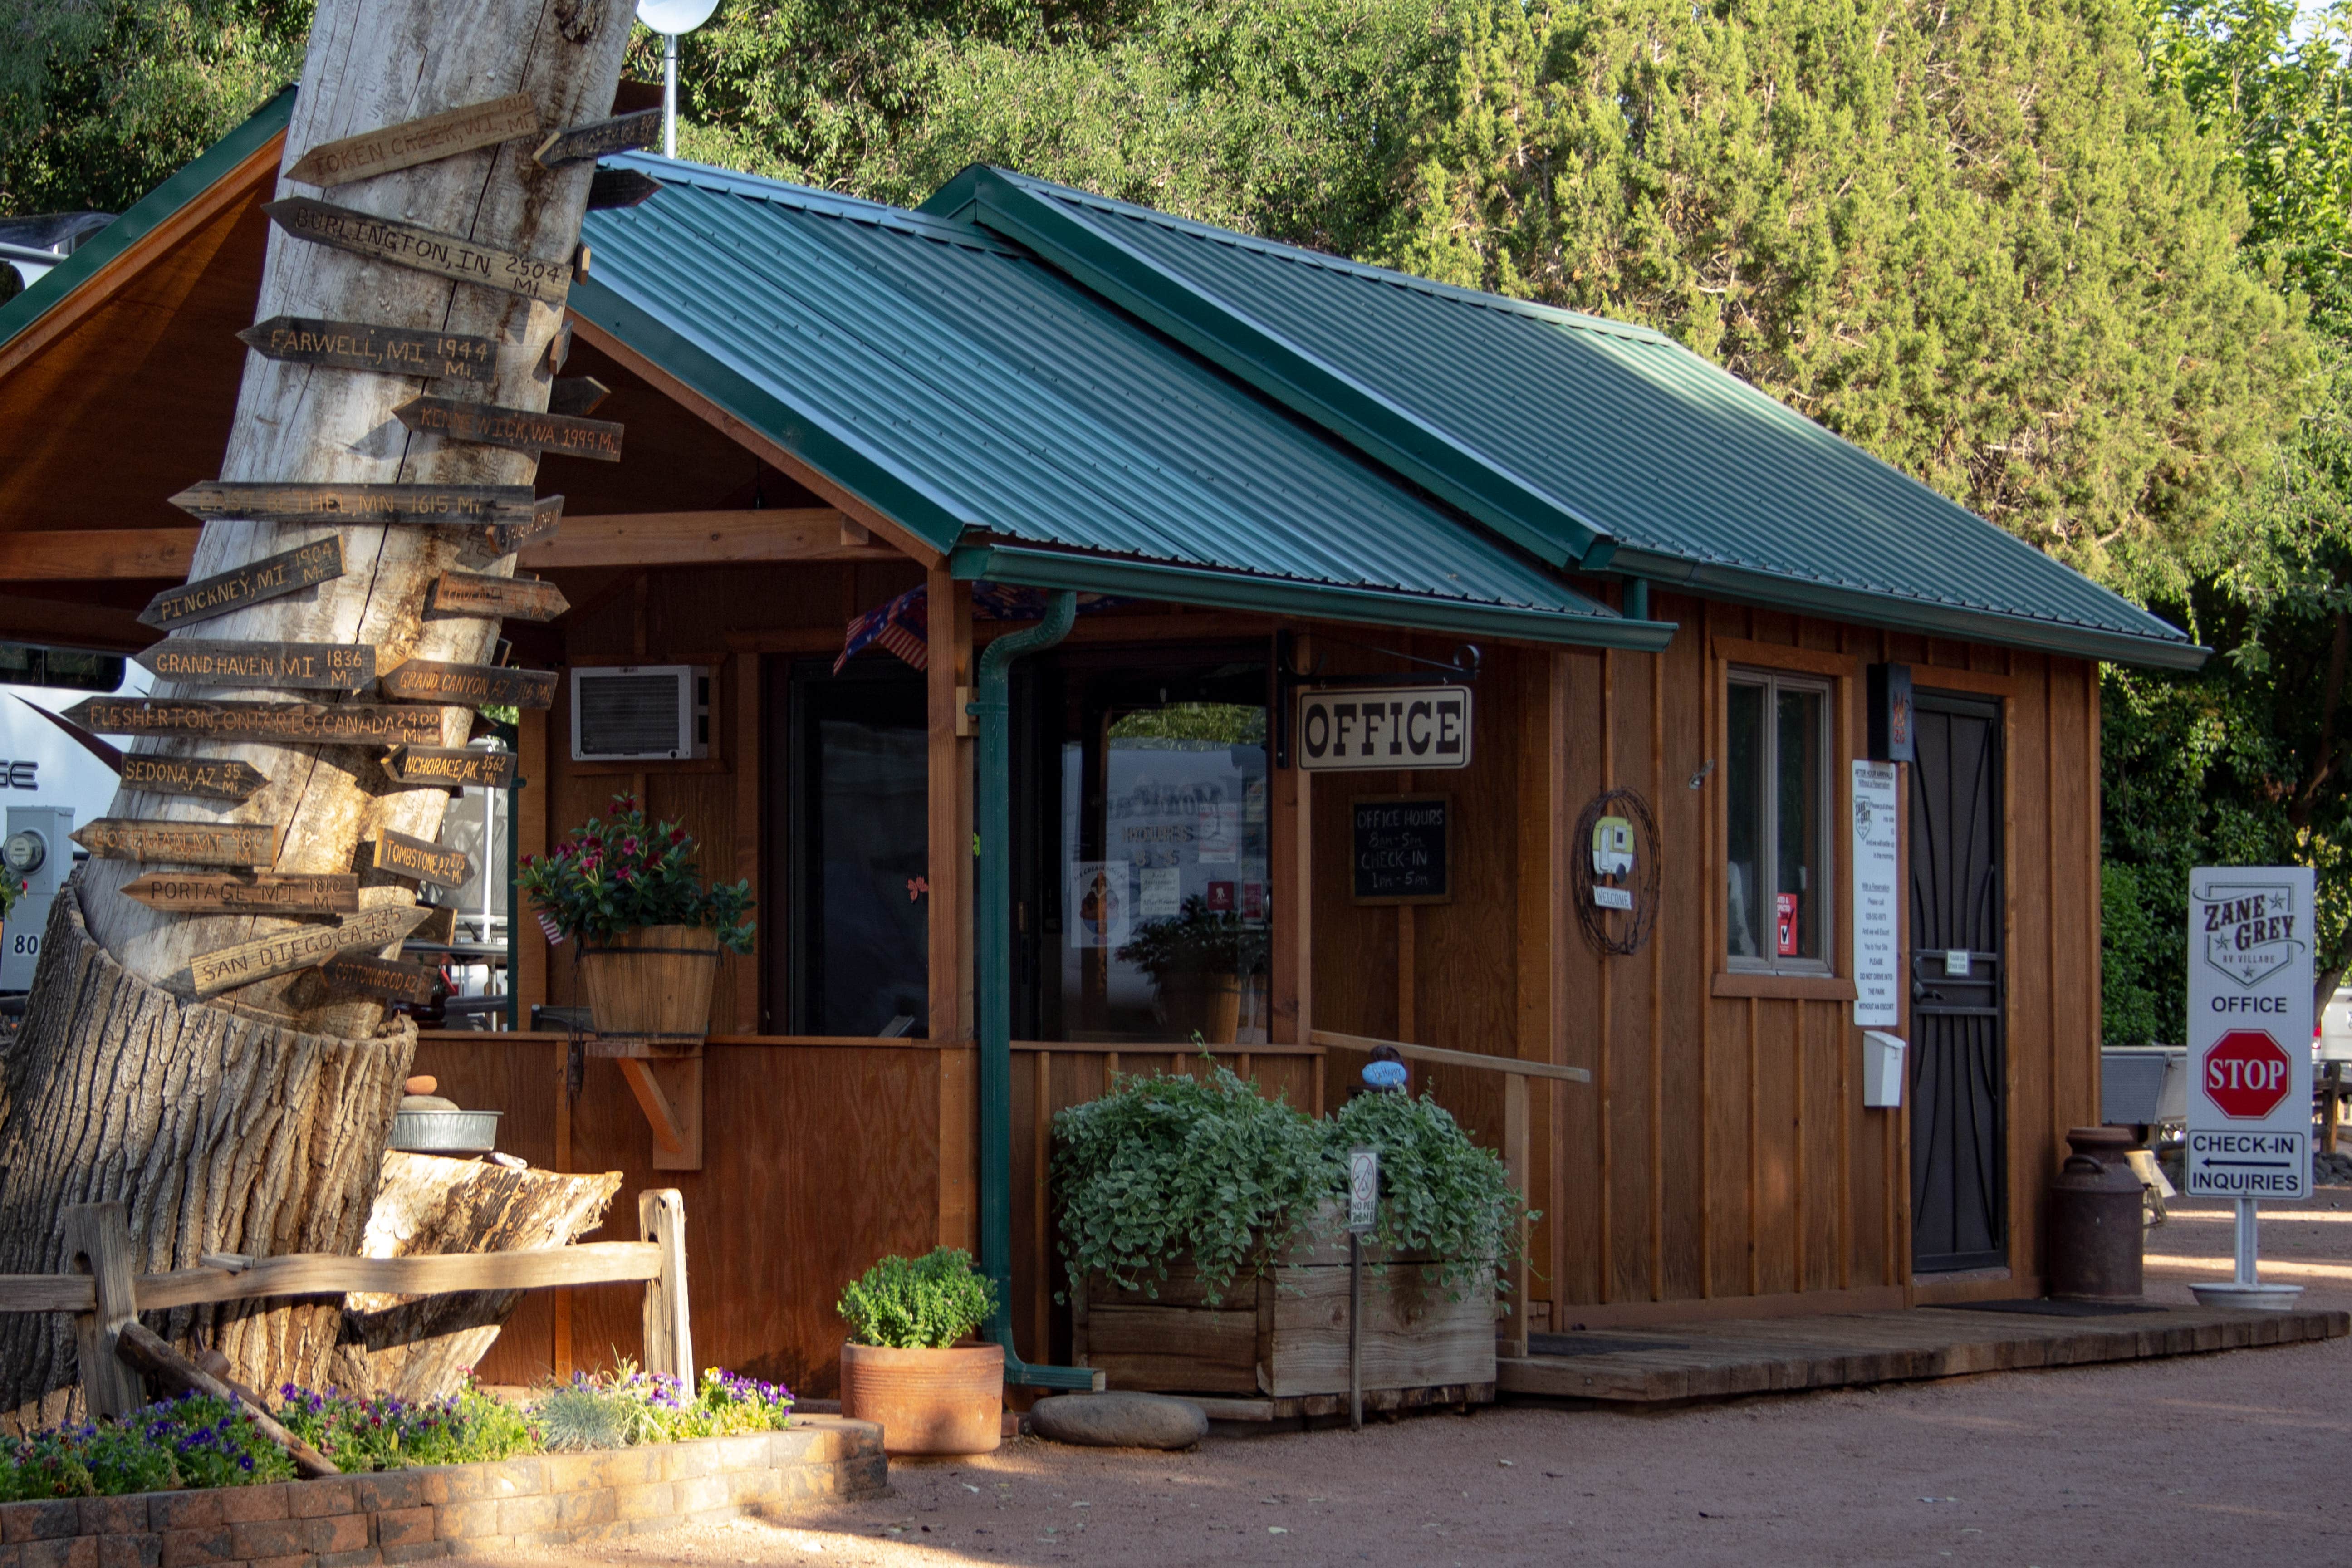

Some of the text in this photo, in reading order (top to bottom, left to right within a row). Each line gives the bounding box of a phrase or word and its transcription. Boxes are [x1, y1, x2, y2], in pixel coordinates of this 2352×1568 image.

[500, 96, 527, 114] 1810
[311, 142, 383, 176] TOKEN
[391, 124, 464, 155] CREEK,
[296, 207, 451, 270] BURLINGTON,
[506, 256, 560, 284] 2504
[272, 329, 383, 364] FARWELL,
[437, 338, 487, 361] 1944
[561, 428, 595, 449] 1999
[200, 491, 255, 512] EAST
[266, 491, 358, 517] BETHEL,
[359, 494, 394, 513] MN
[412, 495, 448, 514] 1615
[295, 542, 334, 567] 1904
[162, 576, 255, 621] PINCKNEY,
[157, 653, 212, 674] GRAND
[281, 656, 314, 678] MI
[327, 650, 363, 668] 1836
[400, 671, 438, 690] GRAND
[90, 705, 439, 737] FLESHERTON, ONTARIO, CANADA 2400
[1305, 701, 1460, 758] OFFICE
[482, 755, 506, 772] 3562
[126, 761, 193, 791] SEDONA,
[224, 763, 240, 779] 35
[1357, 808, 1445, 829] OFFICE HOURS
[232, 828, 264, 849] 980
[1122, 825, 1189, 843] HOURS
[387, 839, 438, 878] TOMBSTONE,
[451, 853, 466, 871] 275
[1404, 871, 1428, 886] 5PM
[151, 881, 255, 905] PORTAGE,
[308, 878, 342, 894] 1810
[1596, 888, 1629, 908] WELCOME
[364, 908, 401, 930] 435
[2204, 894, 2265, 932] ZANE
[2234, 914, 2295, 952] GREY
[14, 935, 39, 955] 80
[203, 955, 249, 982] SAN
[260, 933, 338, 967] DIEGO,
[2223, 954, 2275, 964] RV VILLAGE
[1880, 1003, 1894, 1011] ESCORT
[2212, 996, 2287, 1014] OFFICE
[2208, 1058, 2285, 1090] STOP
[2193, 1136, 2294, 1154] CHECK-IN
[2192, 1172, 2298, 1191] INQUIRIES
[1352, 1200, 1374, 1210] NO PEE
